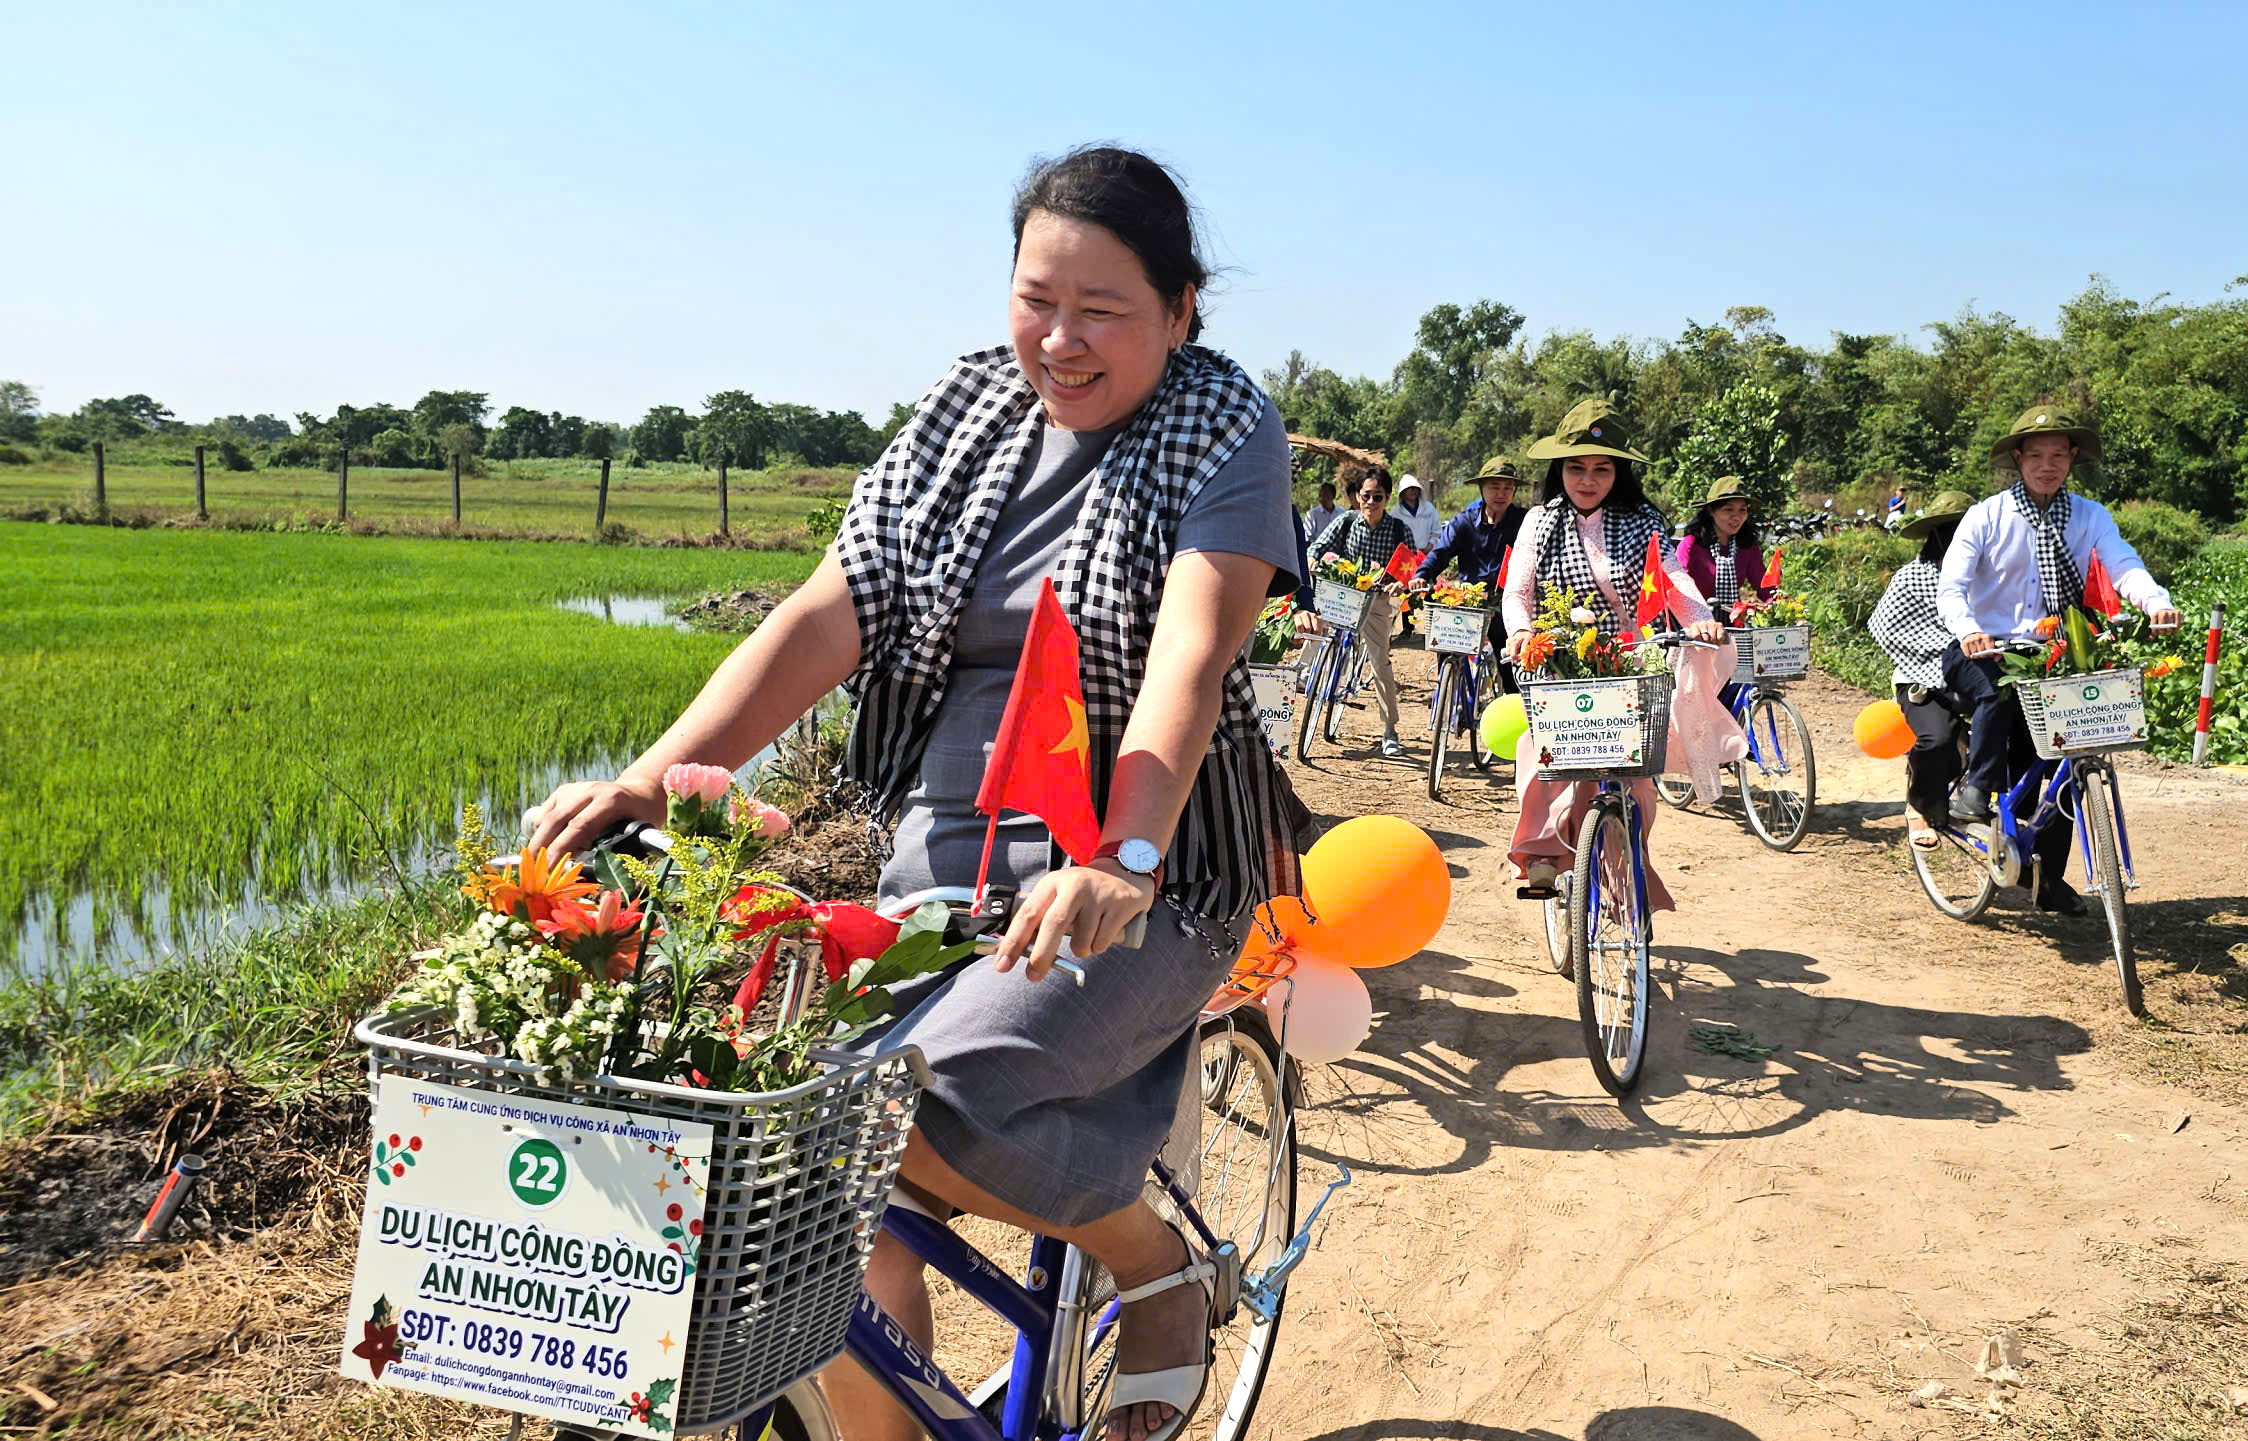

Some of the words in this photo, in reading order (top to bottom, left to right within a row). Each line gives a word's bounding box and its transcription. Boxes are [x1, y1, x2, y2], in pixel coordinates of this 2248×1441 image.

[2084, 689, 2097, 698] 15
[1576, 698, 1592, 708] 07
[1538, 721, 1550, 730] DU
[1554, 720, 1574, 731] LỊCH
[1577, 718, 1604, 730] CỘNG
[2066, 720, 2078, 728] AN
[2082, 728, 2100, 736] 0839
[2102, 726, 2114, 734] 788
[2117, 724, 2130, 732] 456
[1555, 734, 1568, 742] AN
[1570, 732, 1598, 740] NHƠN
[1572, 746, 1590, 755] 0839
[1593, 746, 1608, 754] 788
[1610, 744, 1624, 753] 456
[412, 1092, 444, 1108] TRUNG
[448, 1096, 468, 1112] TÂM
[470, 1102, 498, 1116] CUNG
[500, 1104, 521, 1120] ỨNG
[524, 1110, 548, 1124] DỊCH
[550, 1114, 564, 1128] VỤ
[566, 1116, 594, 1131] CÔNG
[596, 1120, 610, 1134] XÃ
[612, 1124, 628, 1136] AN
[630, 1126, 660, 1142] NHƠN
[662, 1130, 682, 1144] TÂY
[515, 1152, 559, 1192] 22
[381, 1206, 420, 1239] DU
[427, 1214, 494, 1253] LỊCH
[501, 1224, 584, 1269] CỘNG
[592, 1237, 678, 1285] ĐỒNG
[420, 1262, 464, 1296] AN
[470, 1270, 557, 1314] NHƠN
[564, 1284, 622, 1324] TÂY
[402, 1310, 456, 1346] SĐT:
[464, 1321, 523, 1358] 0839
[530, 1333, 576, 1369] 788
[582, 1344, 628, 1380] 456
[388, 1362, 429, 1382] Fanpage:
[404, 1350, 432, 1364] Email:
[434, 1355, 616, 1400] dulichcongdongannhontay@gmail.com
